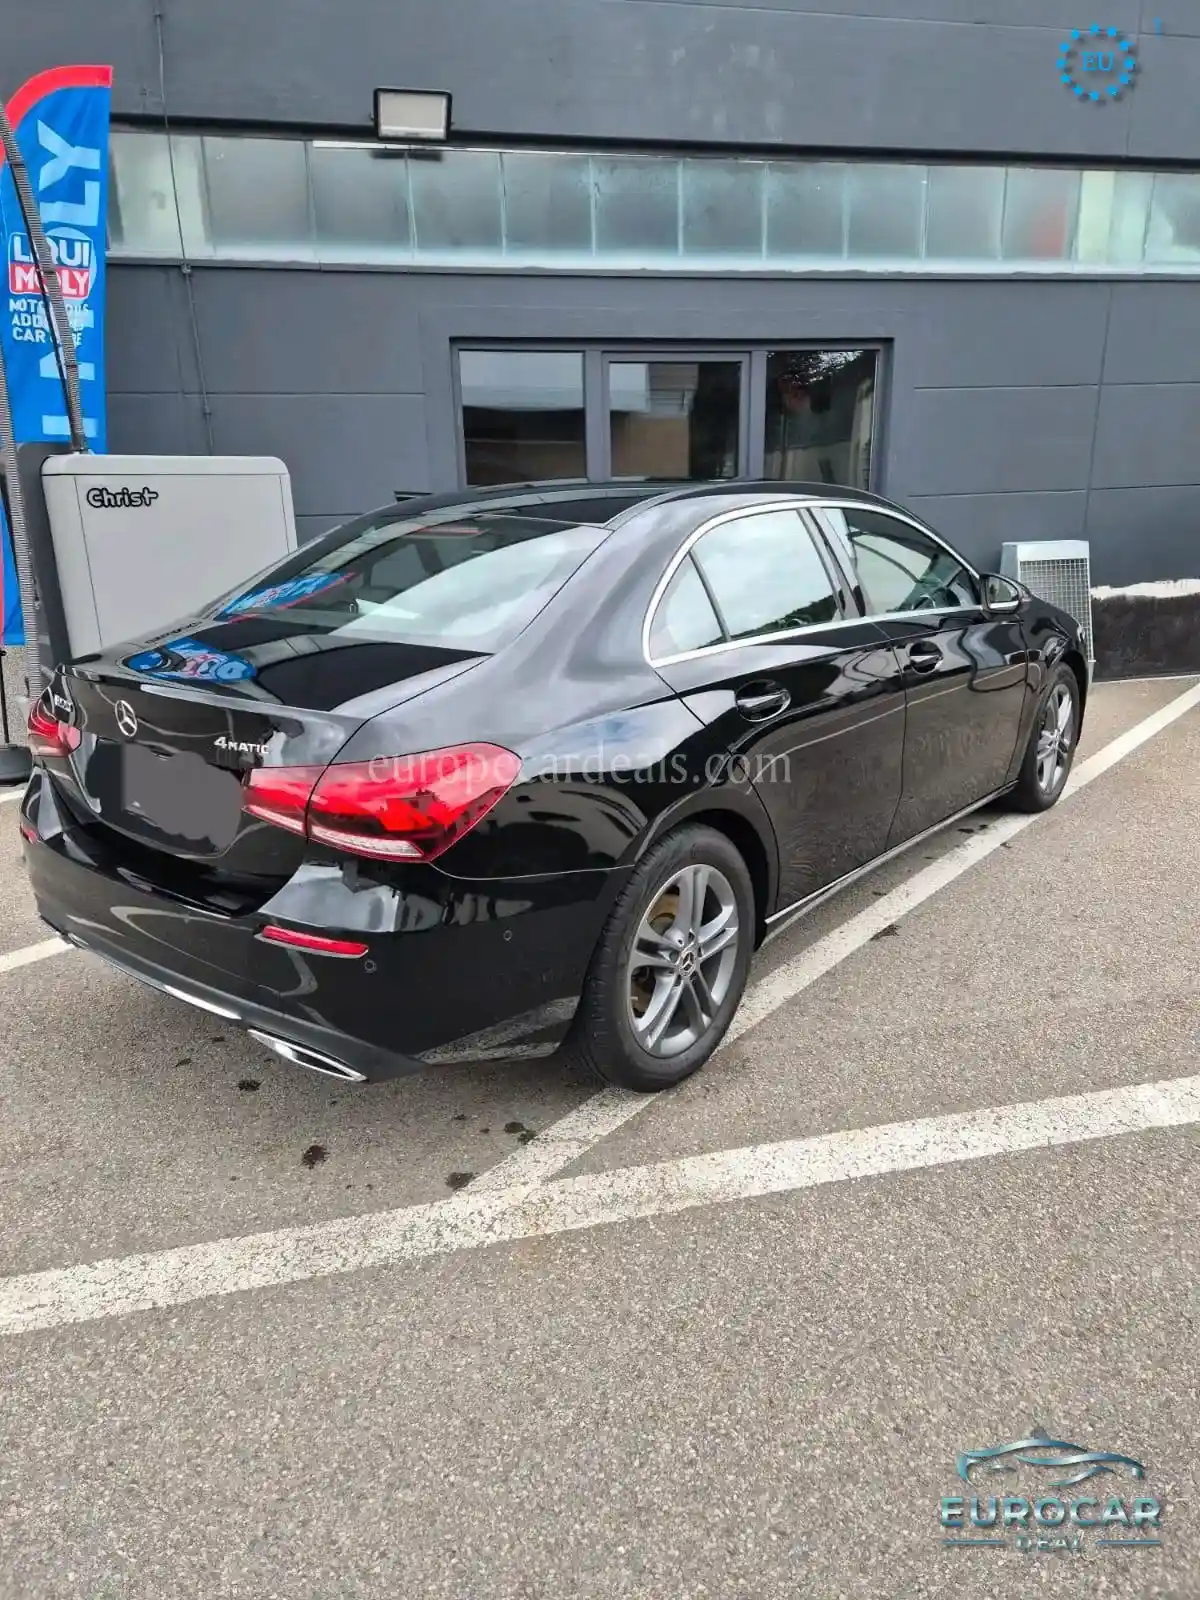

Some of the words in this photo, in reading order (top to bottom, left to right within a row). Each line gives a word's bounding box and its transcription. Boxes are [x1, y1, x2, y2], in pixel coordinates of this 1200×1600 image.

[13, 235, 90, 267] LQUI
[14, 266, 89, 296] MLY
[12, 327, 47, 343] CAR
[86, 486, 159, 508] Christ
[213, 736, 269, 754] 4MATIC
